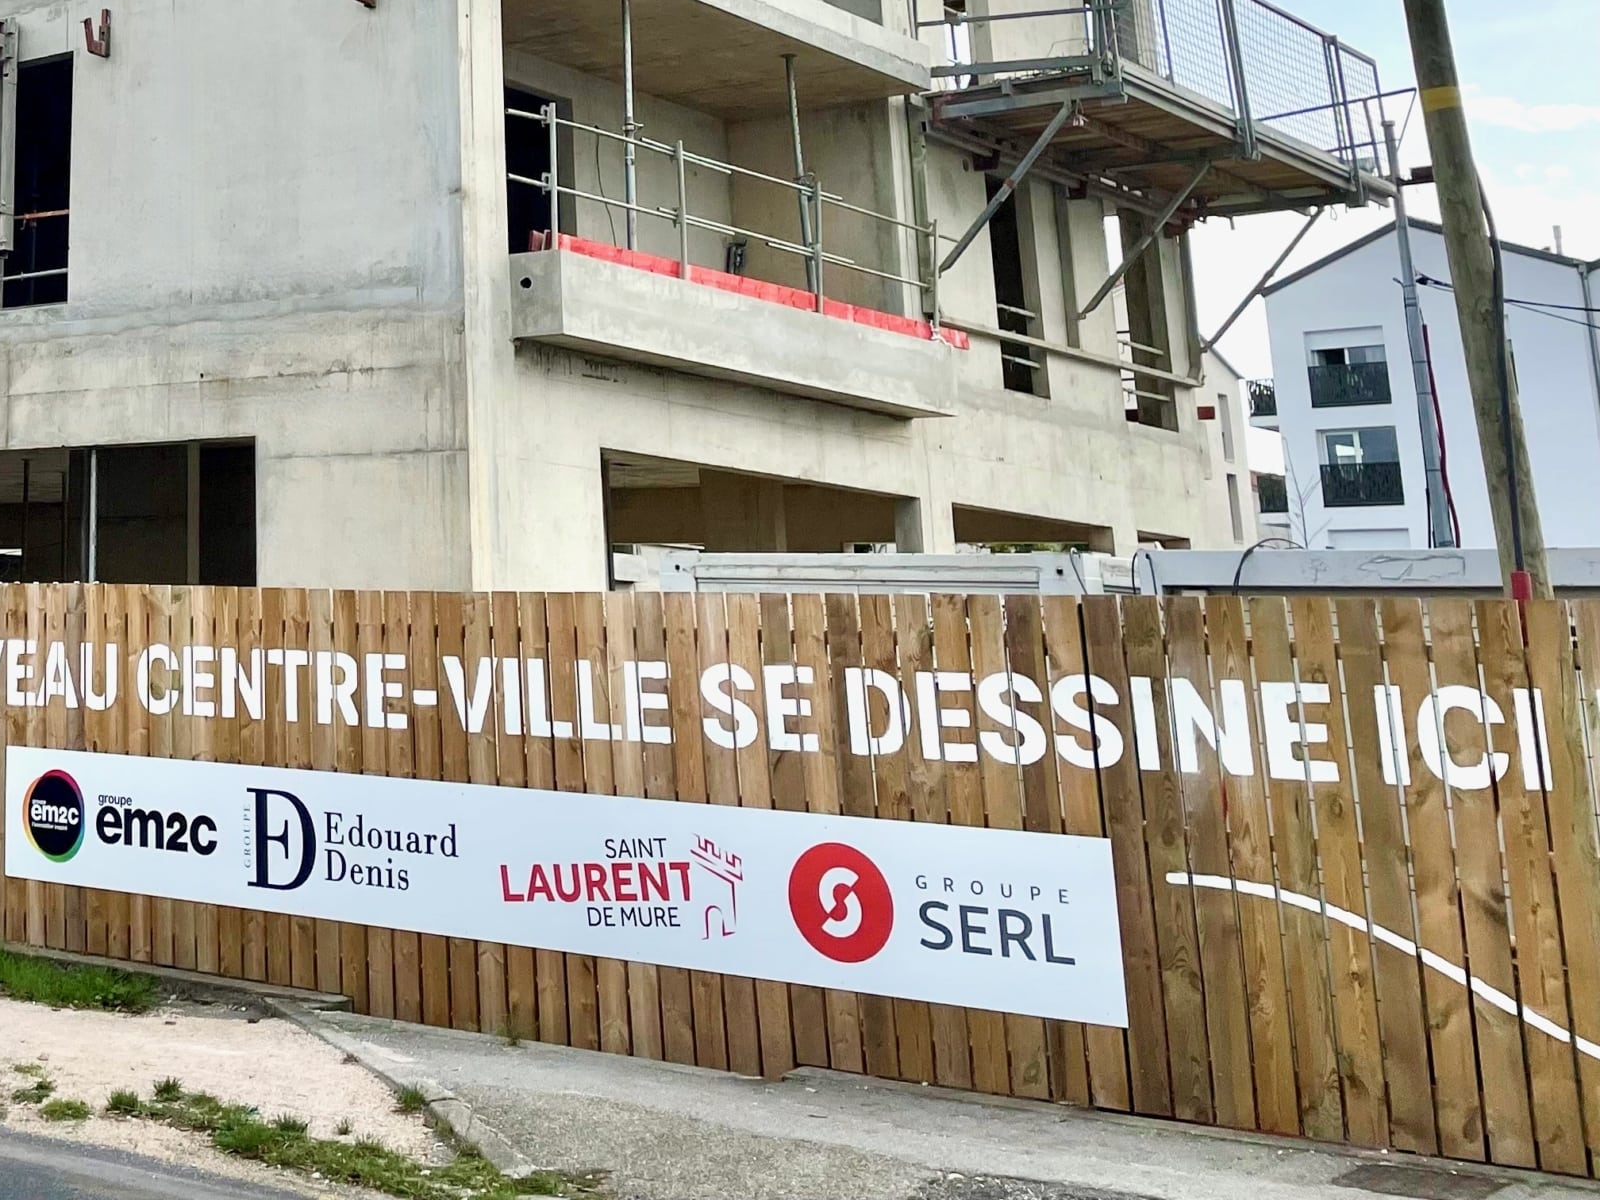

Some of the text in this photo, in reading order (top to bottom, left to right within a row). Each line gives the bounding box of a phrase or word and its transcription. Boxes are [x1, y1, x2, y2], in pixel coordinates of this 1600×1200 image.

[137, 642, 676, 745] CENTRE-VILLE
[700, 663, 820, 752] SE
[845, 666, 1339, 783] DESSINE
[1374, 684, 1553, 791] ICI
[31, 803, 79, 825] em2c
[98, 794, 132, 807] groupe
[95, 805, 218, 856] em2c
[243, 804, 251, 868] GROUPE
[324, 811, 459, 858] Edouard
[604, 837, 667, 860] SAINT
[324, 848, 410, 891] Denis
[501, 861, 693, 902] LAURENT
[915, 874, 1071, 904] GROUPE
[587, 906, 681, 928] DE MURE
[919, 901, 1076, 966] SERL
